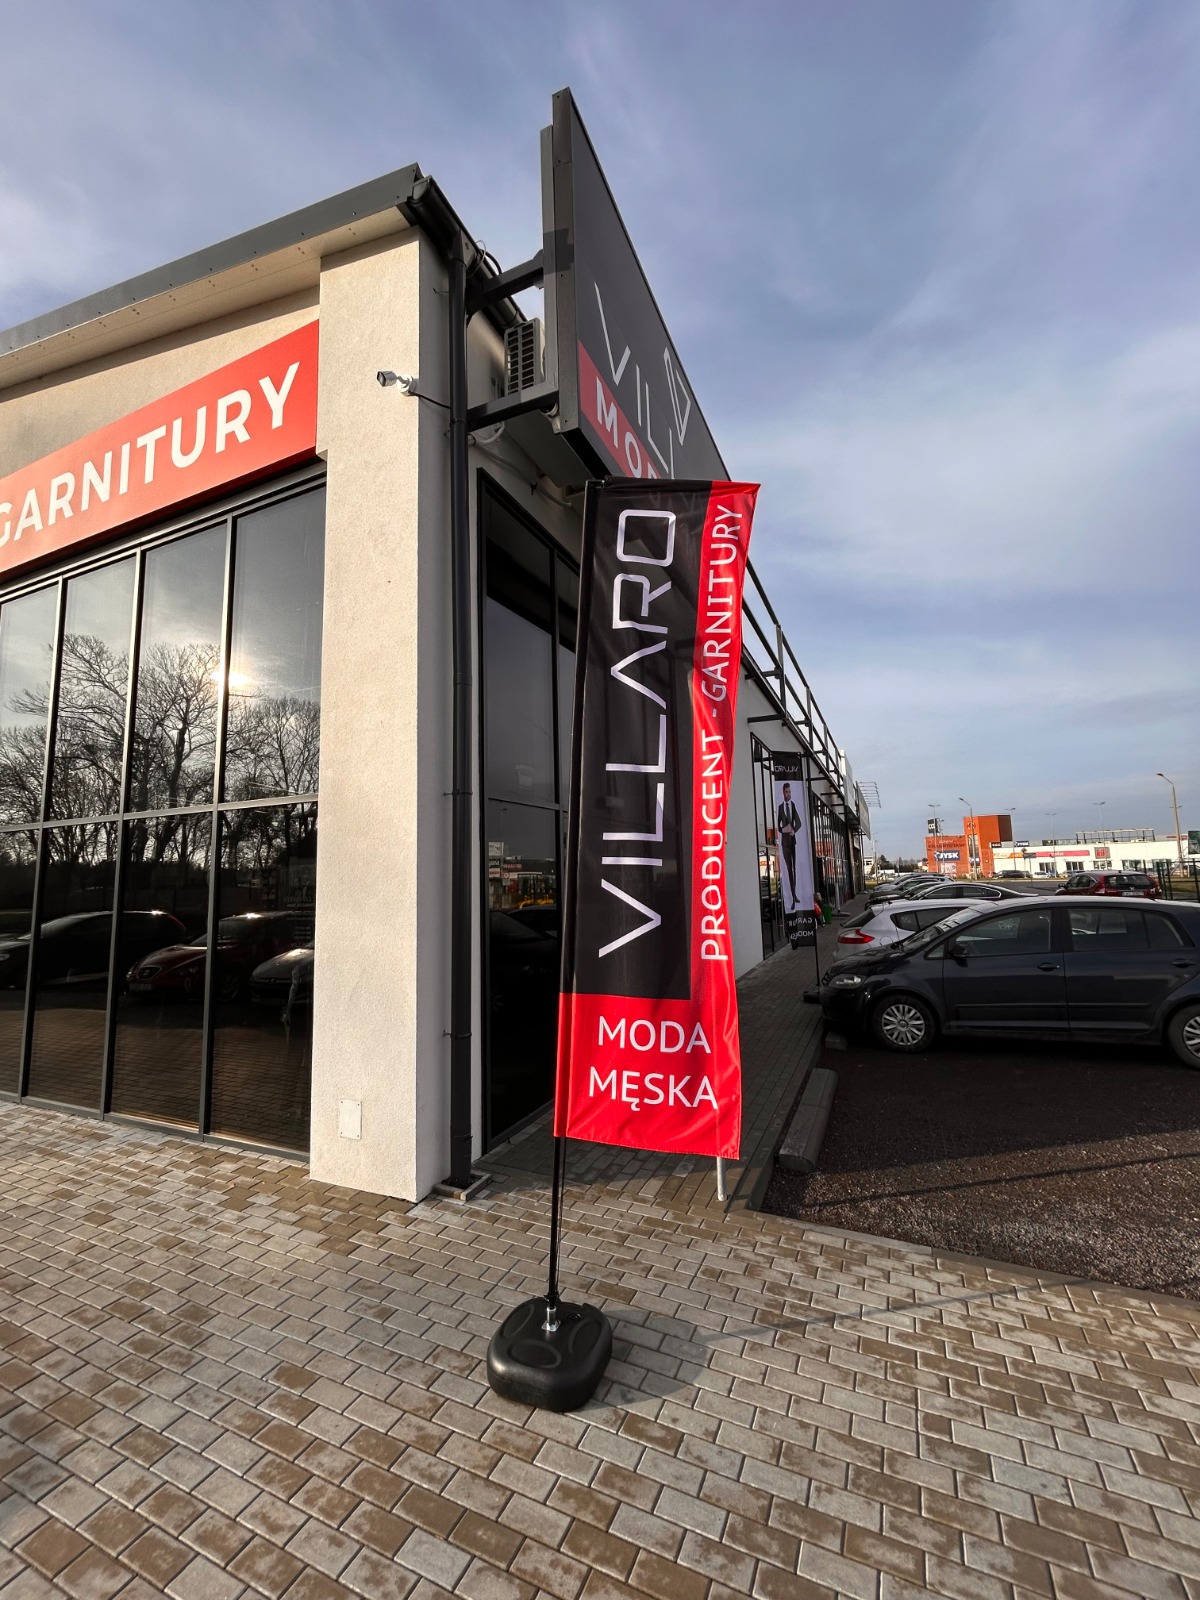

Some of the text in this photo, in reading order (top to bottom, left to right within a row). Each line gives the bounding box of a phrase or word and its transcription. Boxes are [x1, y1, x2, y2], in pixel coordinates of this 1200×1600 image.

[701, 504, 743, 703] GARNITURY
[598, 508, 677, 958] VILLARO
[701, 729, 729, 961] PRODUCENT
[588, 1065, 719, 1112] MĘSKA
[598, 1015, 712, 1054] MODA
